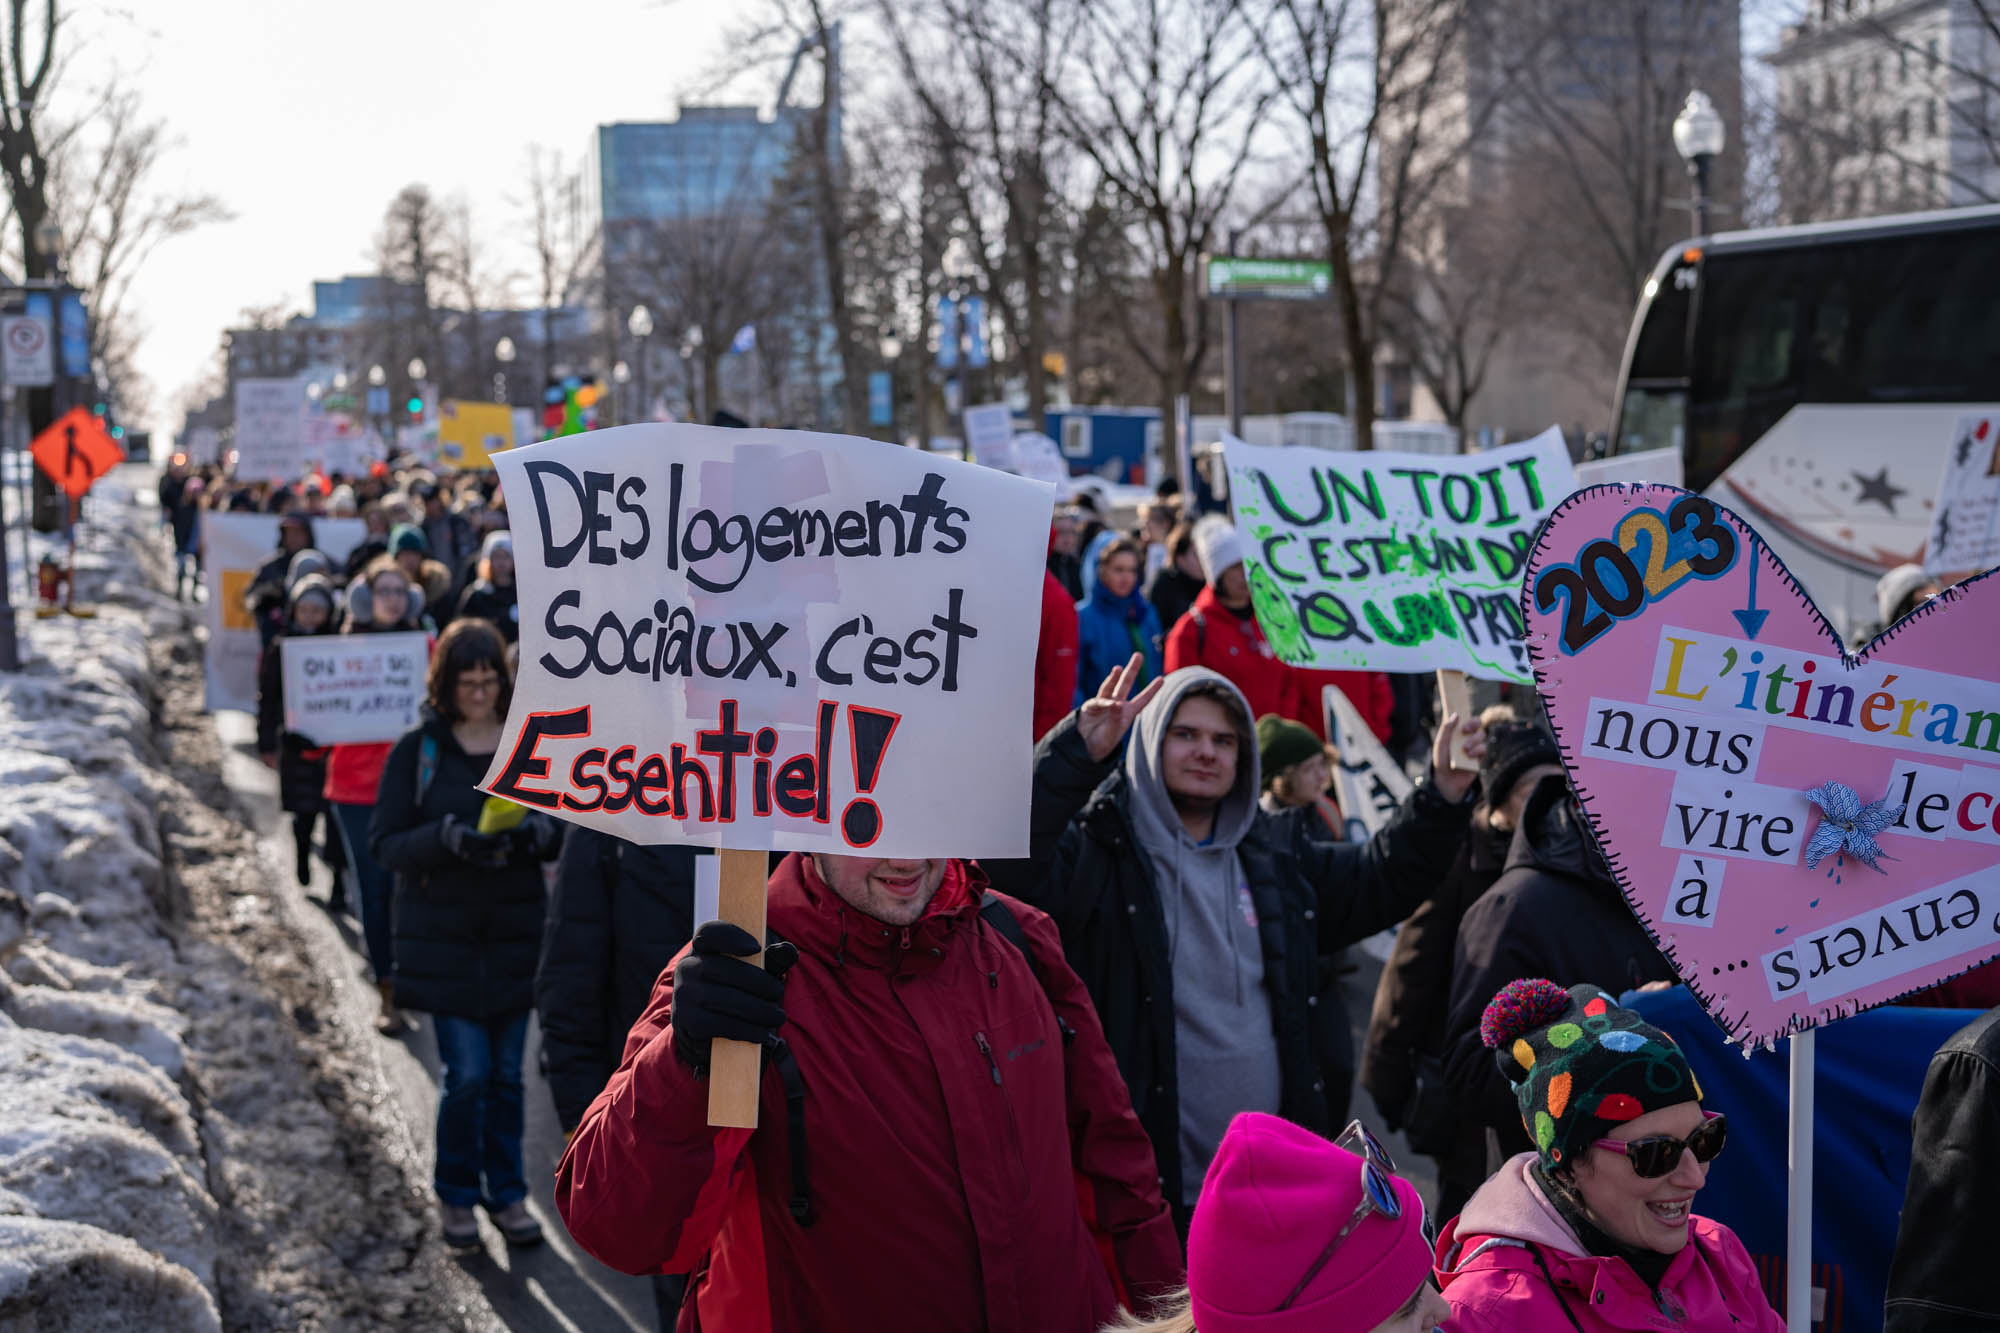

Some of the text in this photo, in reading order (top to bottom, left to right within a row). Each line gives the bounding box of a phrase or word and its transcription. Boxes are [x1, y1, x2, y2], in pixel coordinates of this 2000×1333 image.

[524, 460, 970, 593] DES logements
[1256, 456, 1545, 527] UN TOIT
[1408, 529, 1477, 574] UN
[1535, 496, 1739, 654] 2023
[539, 588, 977, 691] Sociaux, c'est
[487, 699, 902, 848] Essentiel!
[1591, 708, 1754, 774] nous
[1675, 771, 2000, 856] vire le c
[1674, 860, 1709, 920] à
